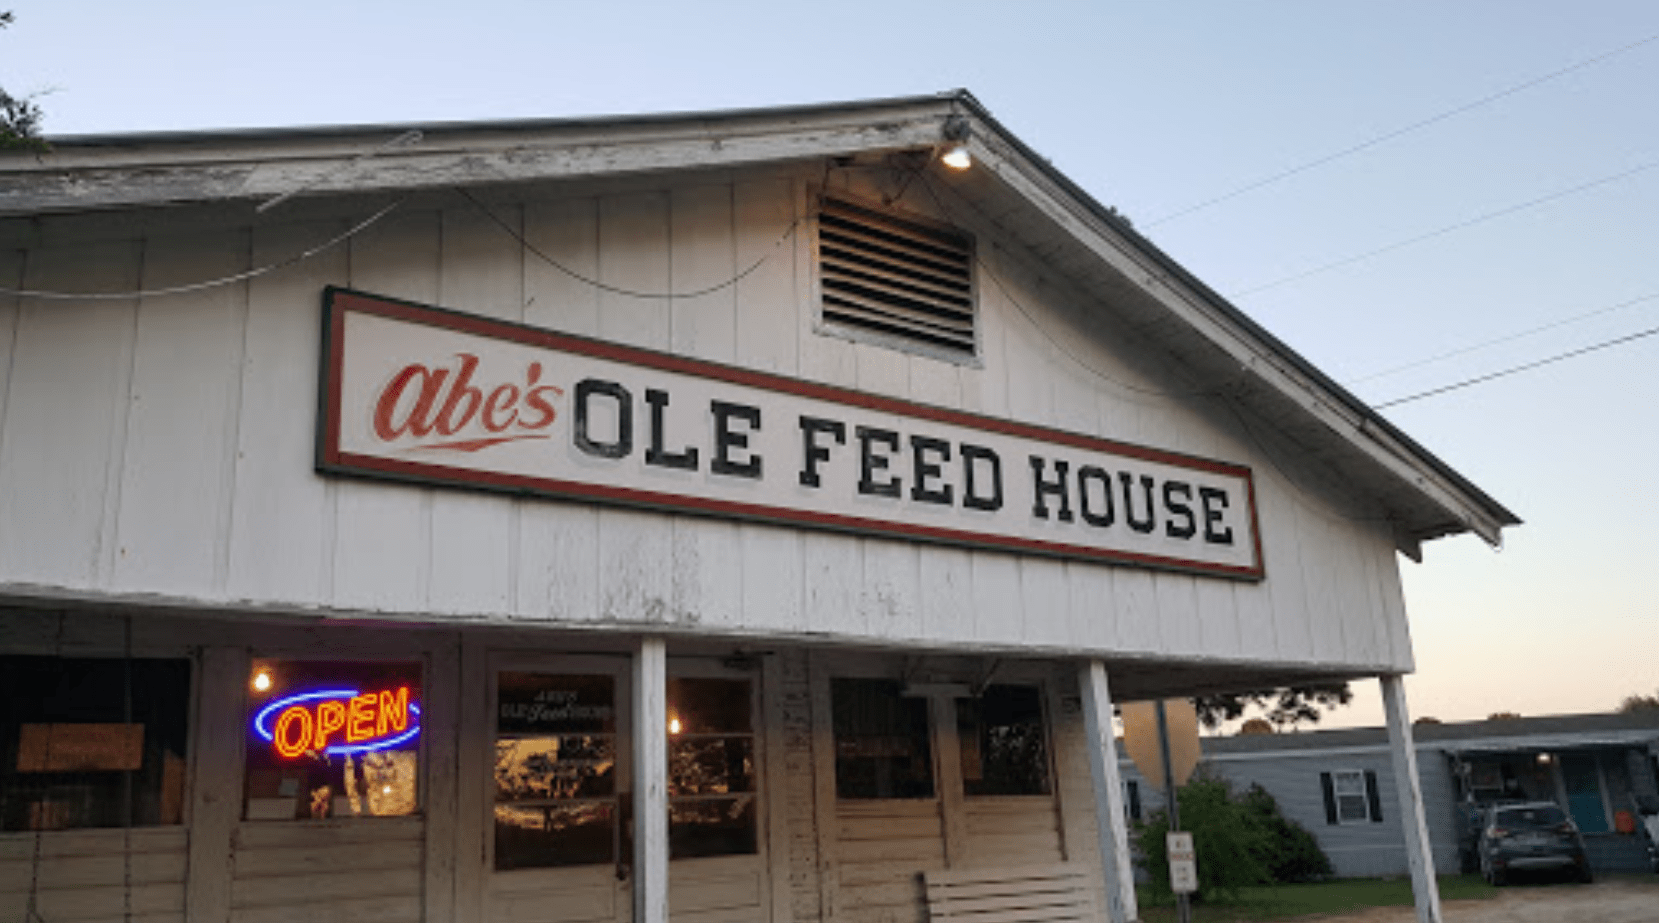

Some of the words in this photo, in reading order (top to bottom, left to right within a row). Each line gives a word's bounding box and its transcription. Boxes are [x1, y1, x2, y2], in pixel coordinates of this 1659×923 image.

[573, 377, 762, 480] OLE
[799, 415, 1003, 511] FEED
[1029, 454, 1233, 544] HOUSE
[274, 686, 409, 758] OPEN
